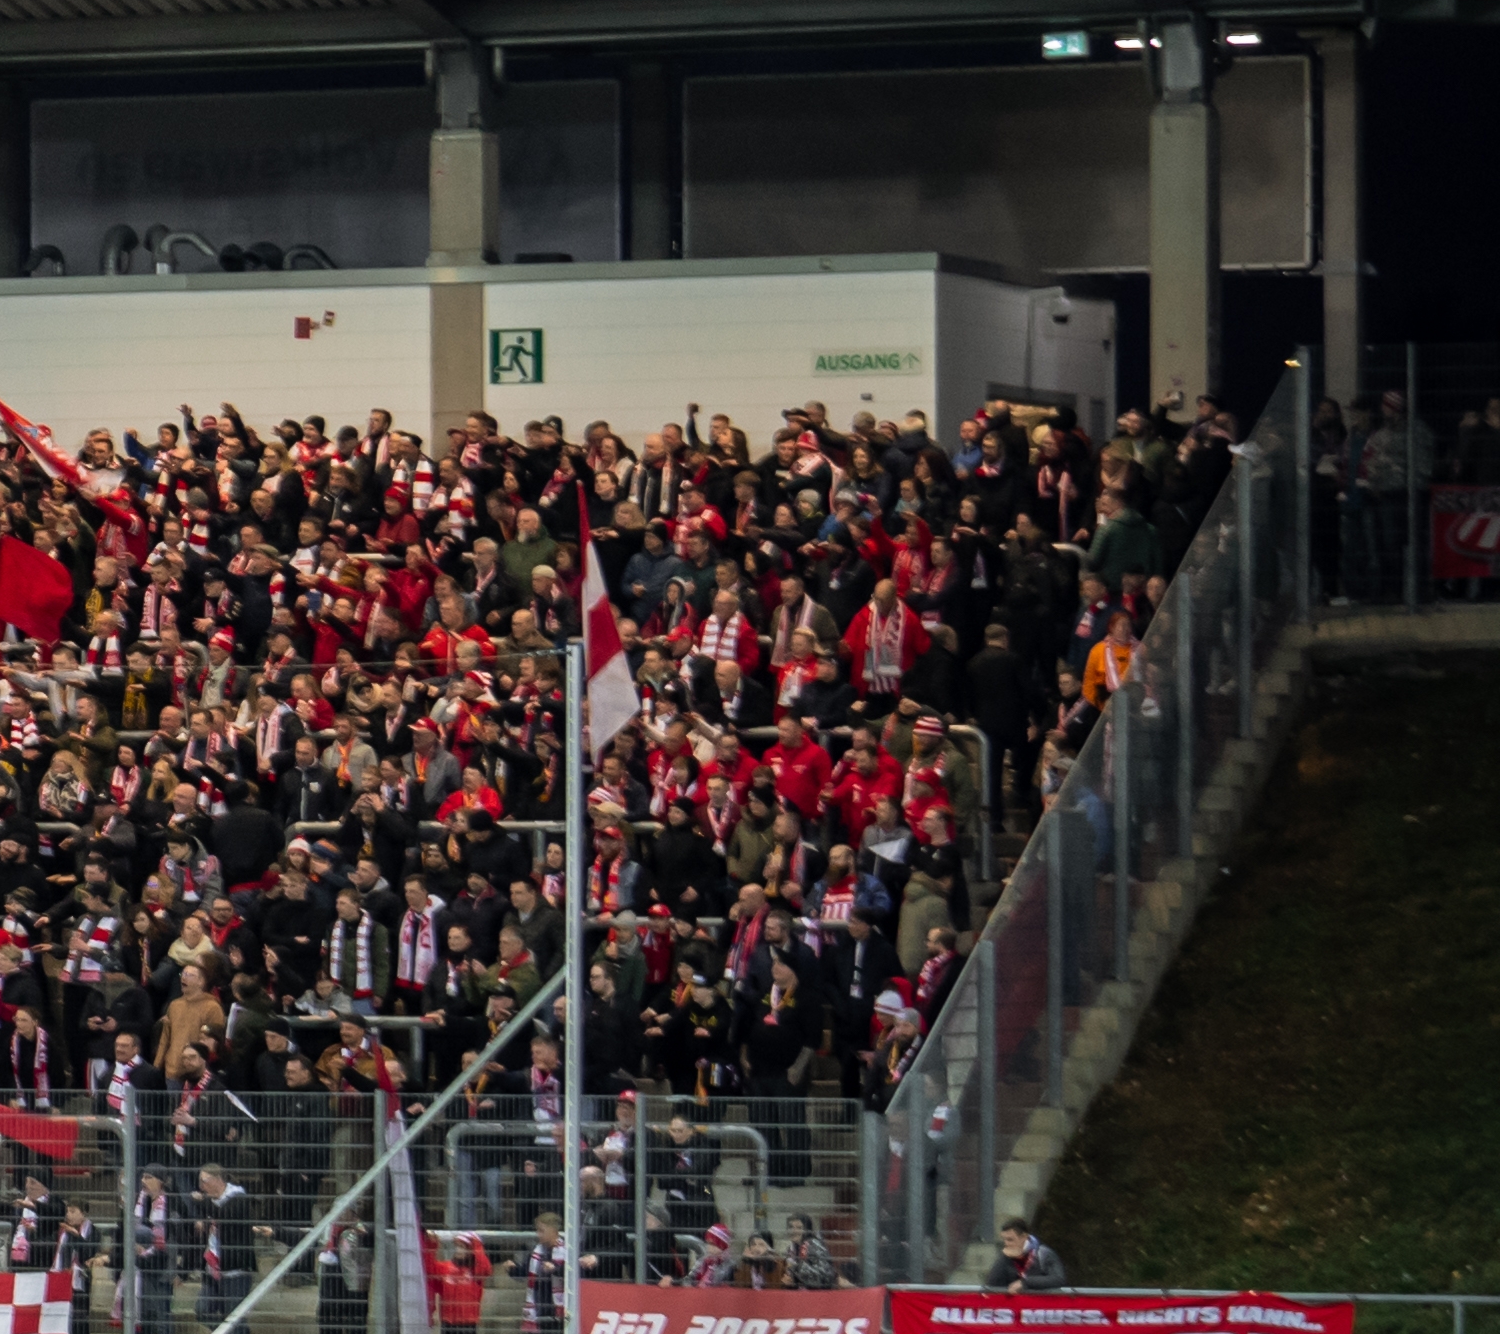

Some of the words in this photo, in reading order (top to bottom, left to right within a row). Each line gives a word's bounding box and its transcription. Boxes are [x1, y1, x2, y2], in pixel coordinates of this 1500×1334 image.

[814, 351, 901, 373] AUSGANG
[930, 1306, 1015, 1325] ALLES
[1116, 1306, 1222, 1325] NICHTS
